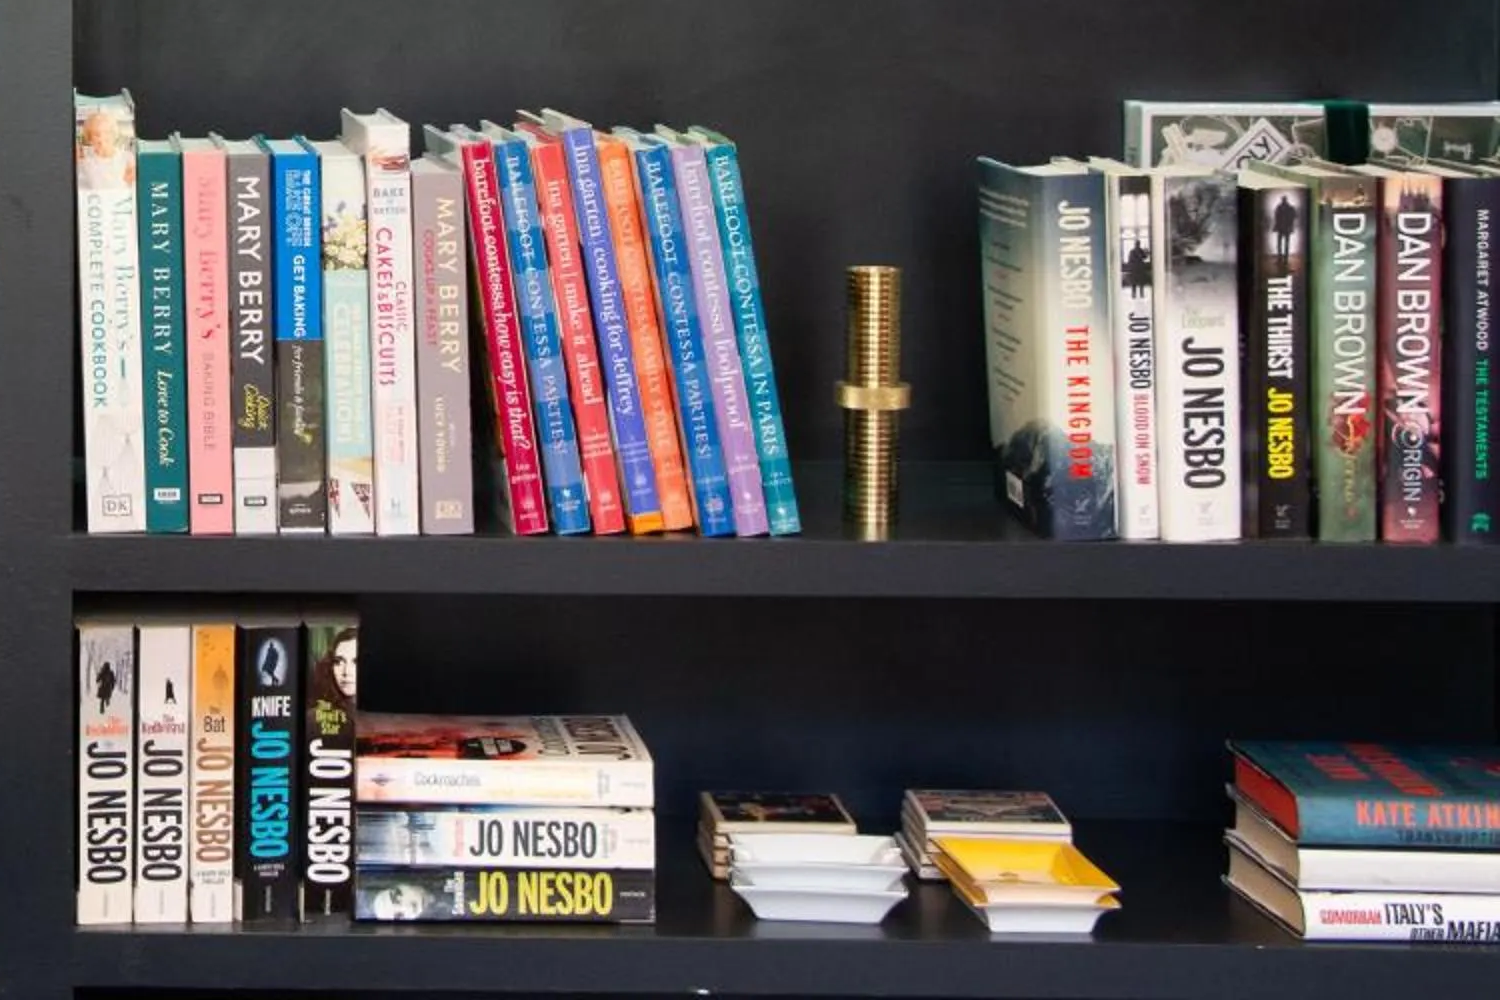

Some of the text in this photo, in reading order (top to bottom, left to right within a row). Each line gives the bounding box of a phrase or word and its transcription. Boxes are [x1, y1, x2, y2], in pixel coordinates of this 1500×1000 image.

[150, 182, 173, 354] MARY BERRY
[237, 176, 264, 365] MARY BERRY
[293, 255, 306, 337] GET BAKING
[376, 227, 393, 292] CAKES
[436, 198, 462, 374] MARY BERRY
[1058, 201, 1092, 306] JO NESBO
[1476, 209, 1489, 350] MARGARET ATWOOD
[86, 194, 107, 408] COMPLETE COOKBOOK
[377, 303, 397, 386] BISCUITS
[471, 158, 530, 448] barefoot contessa how easy is that?
[713, 155, 780, 455] BAREFOOT CONTESSA IN PARIS
[1268, 276, 1293, 379] THE THIRST
[1333, 213, 1365, 414] DAN BROWN
[1396, 213, 1431, 413] DAN BROWN
[1128, 313, 1151, 389] JO NESBO
[157, 370, 174, 466] Love to Cook
[1065, 326, 1093, 480] THE KINGDOM
[1134, 394, 1151, 484] BLOOD ON SNOW
[1182, 337, 1226, 489] JO NESBO
[1268, 387, 1293, 478] JO NESBO
[1476, 360, 1490, 479] THE TESTAMENTS
[204, 717, 226, 732] Bat
[251, 722, 290, 759] JO
[252, 698, 291, 717] KNIFE
[321, 722, 341, 735] Star
[197, 738, 233, 775] JO
[415, 772, 480, 787] Cockroaches
[87, 741, 126, 884] JO NESBO
[142, 739, 182, 882] JO NESBO
[196, 781, 232, 863] NESBO
[250, 768, 289, 858] NESBO
[307, 739, 352, 884] JO NESBO
[470, 820, 504, 857] JO
[513, 822, 597, 858] NESBO
[1356, 800, 1500, 828] KATE ATKIN
[471, 873, 507, 915] JO
[518, 873, 613, 915] NESBO
[1385, 903, 1443, 926] ITALY'S
[1446, 920, 1500, 941] MAFIA
